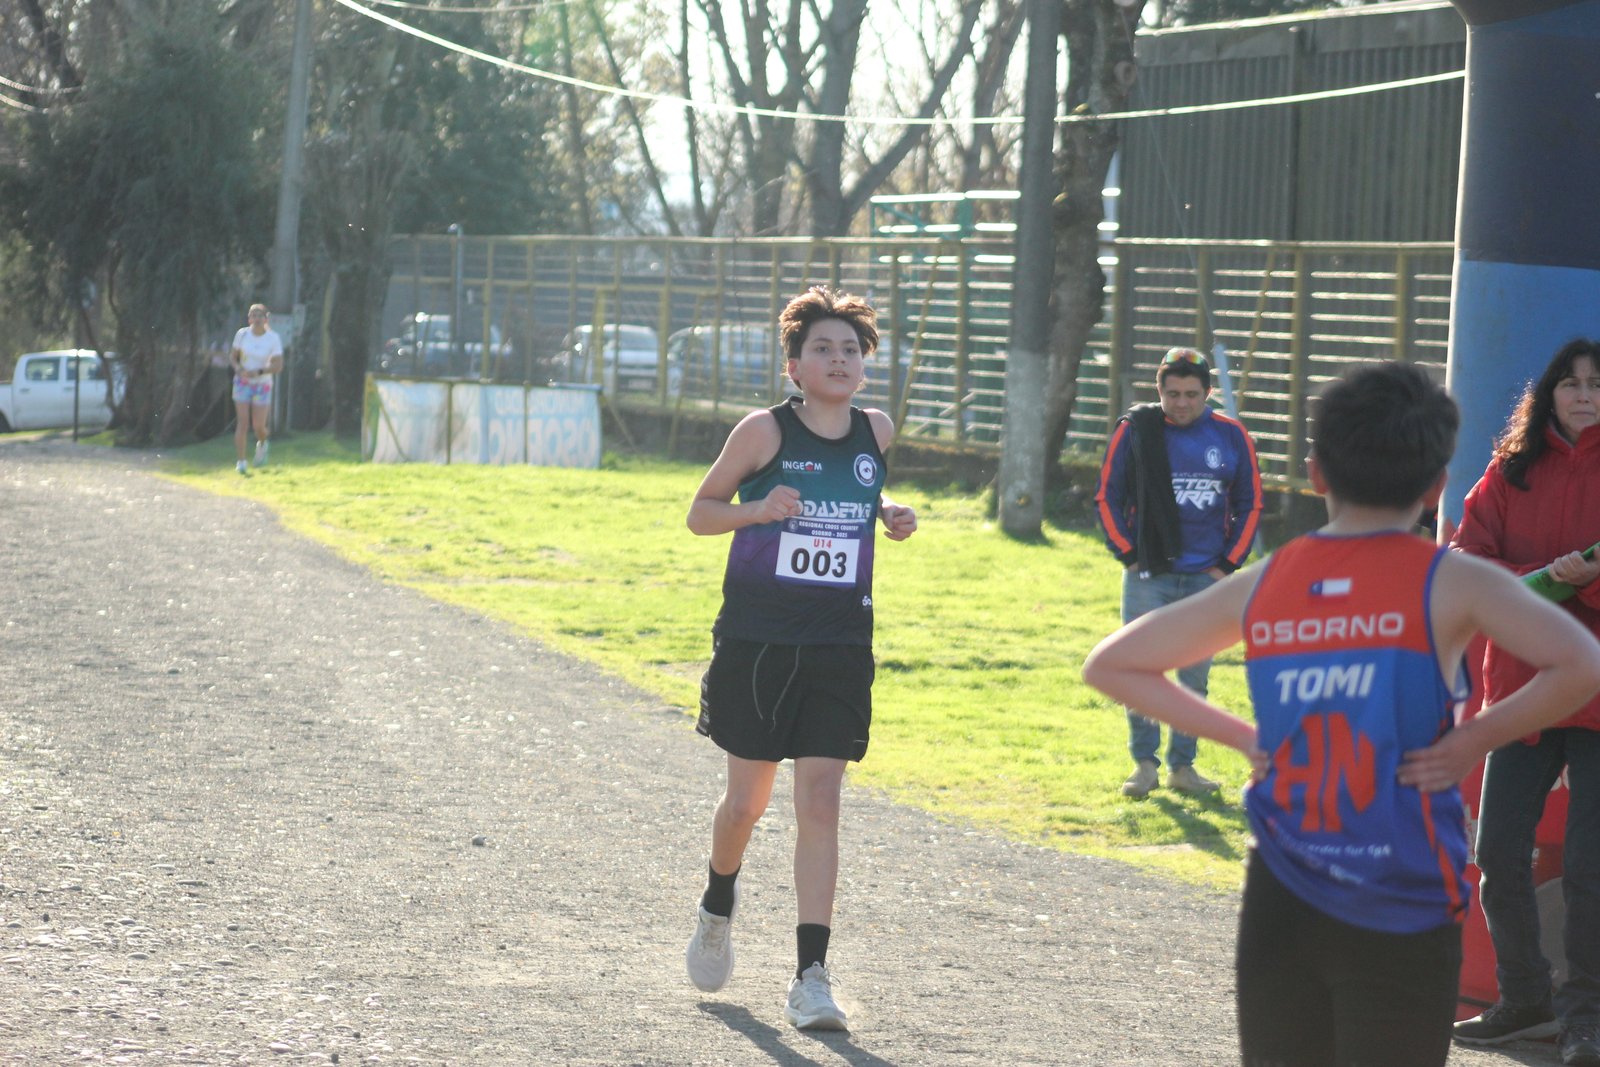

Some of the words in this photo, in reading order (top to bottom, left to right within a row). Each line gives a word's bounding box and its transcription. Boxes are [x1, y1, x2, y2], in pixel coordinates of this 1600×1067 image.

[1172, 478, 1222, 494] CTOR
[824, 523, 840, 531] CROSS
[813, 538, 832, 549] U14
[790, 548, 847, 578] 003
[1251, 612, 1404, 646] OSORNO
[1275, 663, 1375, 706] TOMI
